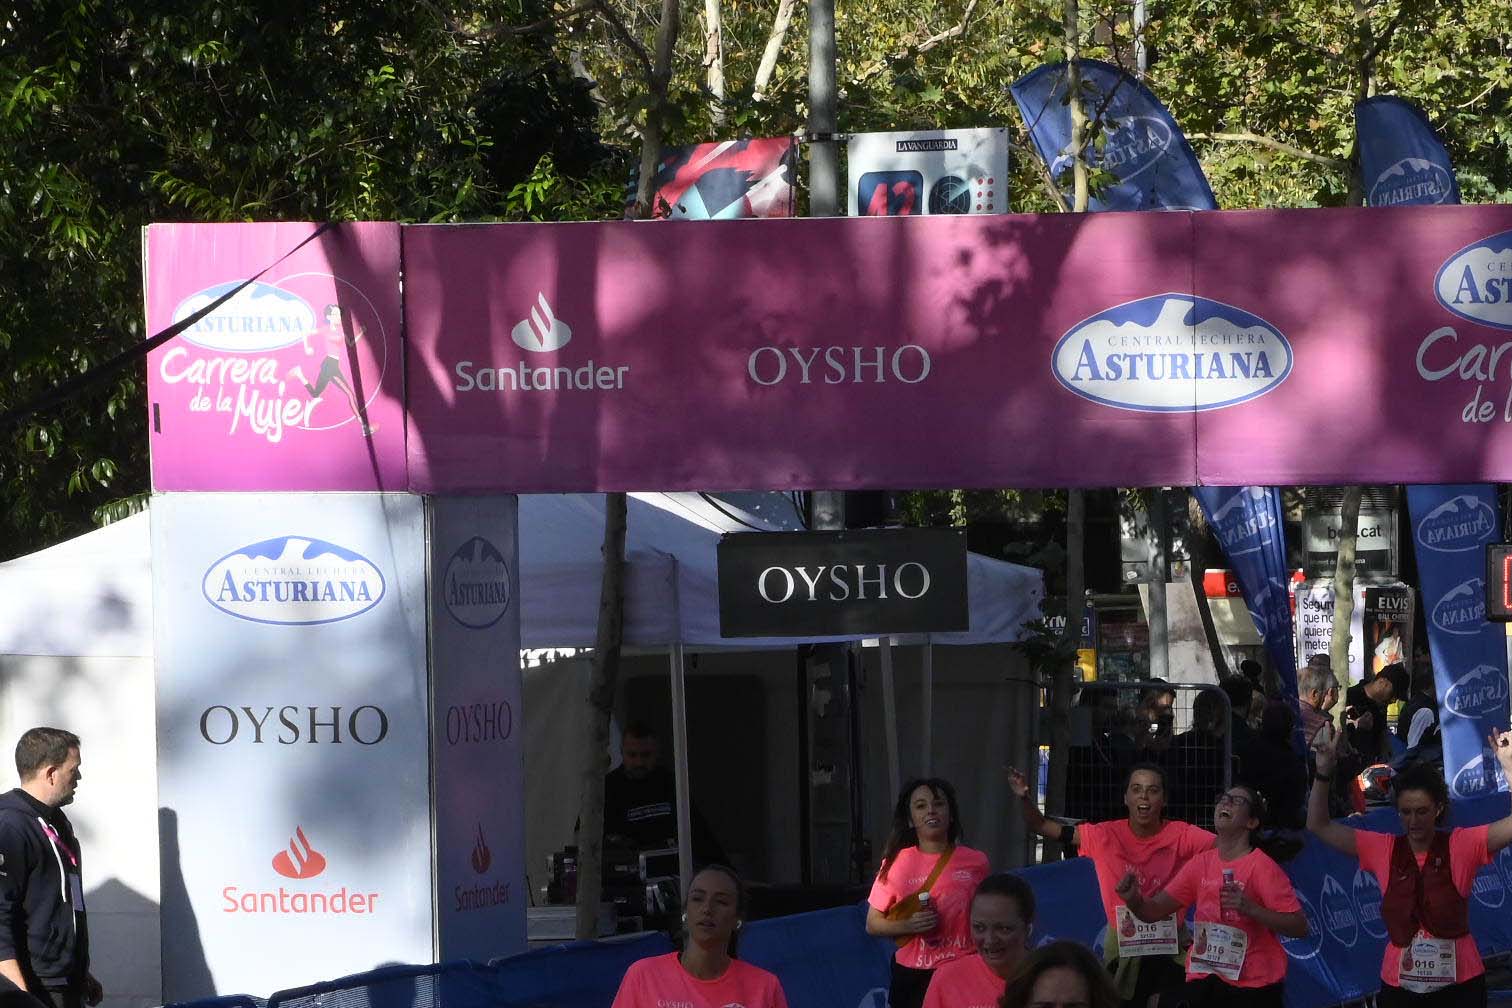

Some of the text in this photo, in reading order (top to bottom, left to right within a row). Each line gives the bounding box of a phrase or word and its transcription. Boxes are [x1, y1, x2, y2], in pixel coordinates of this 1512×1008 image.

[1107, 333, 1267, 347] CENTRAL LECHERA
[160, 345, 279, 385] Carrera
[455, 360, 630, 392] Santander
[748, 345, 931, 384] OYSHO
[1072, 337, 1273, 382] ASTURIANA
[188, 383, 324, 443] de la Mujer
[1462, 384, 1496, 424] de
[217, 569, 373, 603] ASTURIANA
[449, 572, 507, 605] ASTURIANA
[757, 561, 931, 604] OYSHO
[1304, 613, 1319, 626] que
[1378, 597, 1409, 610] ELVIS
[200, 704, 390, 746] OYSHO
[446, 701, 512, 746] OYSHO
[222, 886, 379, 915] Santander
[454, 880, 512, 913] Santander
[1414, 959, 1436, 969] 016
